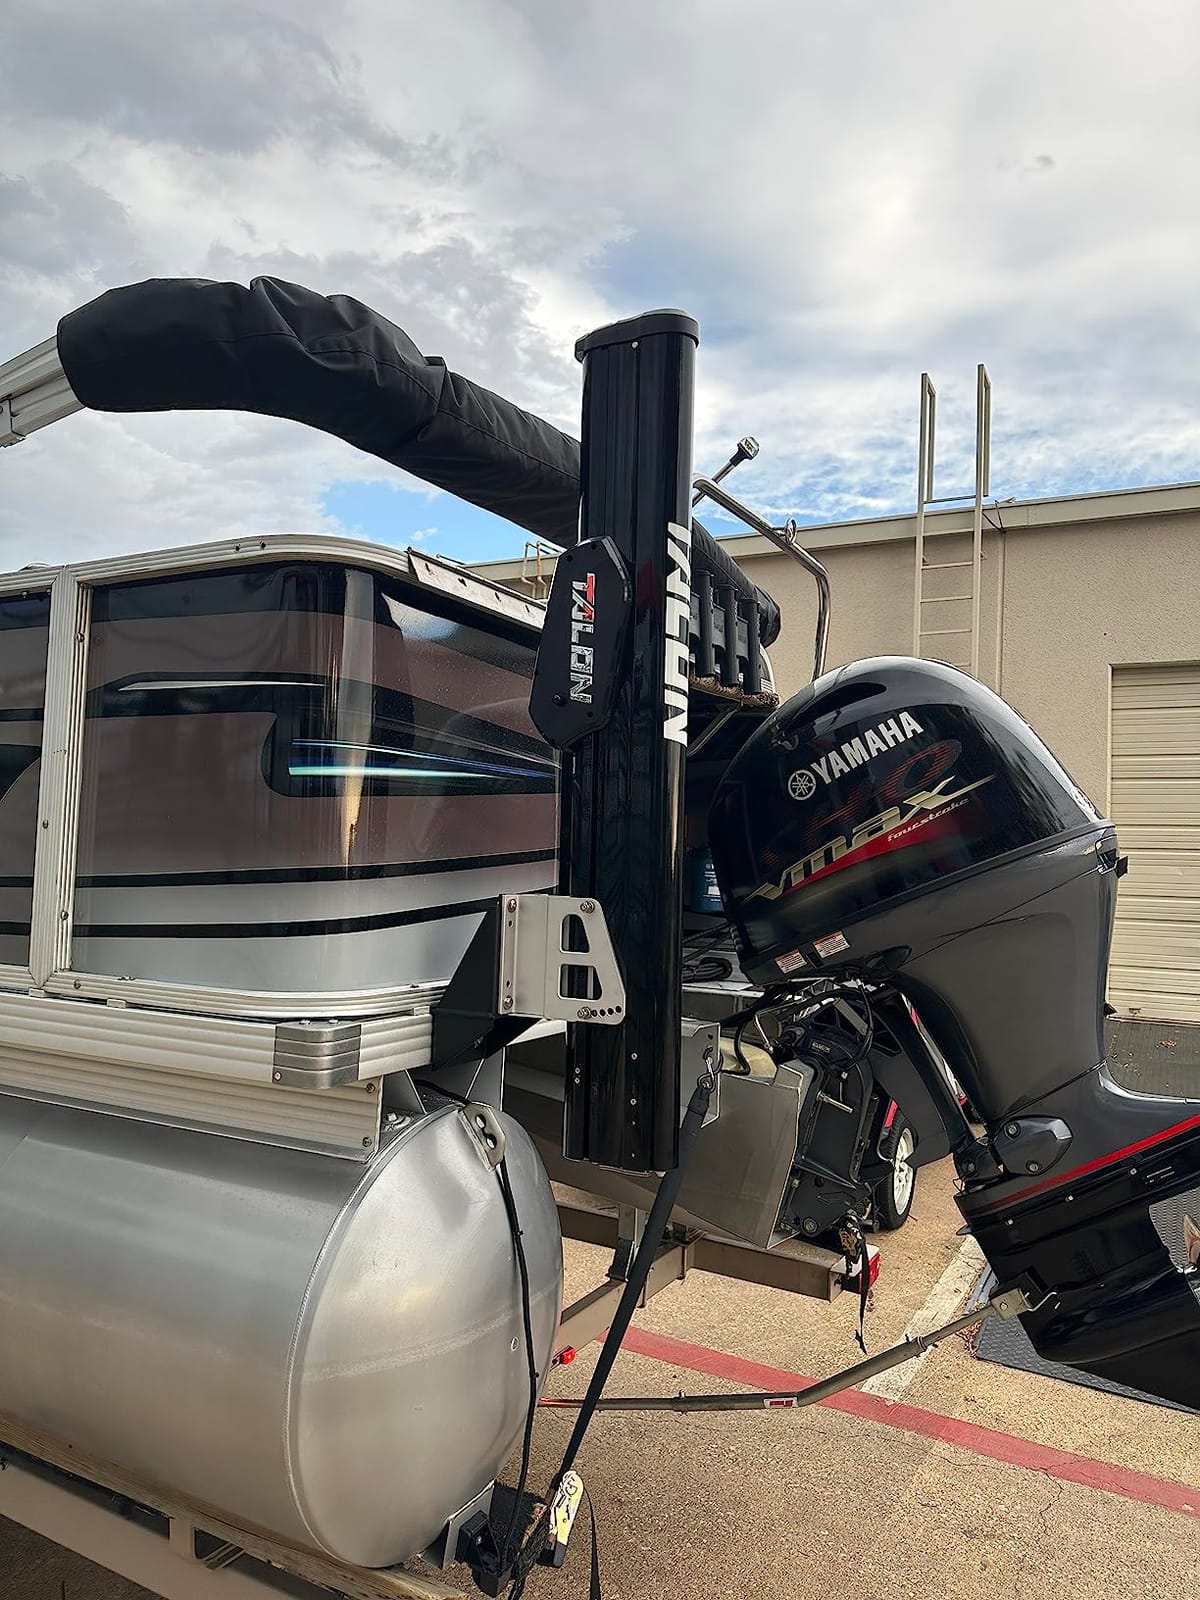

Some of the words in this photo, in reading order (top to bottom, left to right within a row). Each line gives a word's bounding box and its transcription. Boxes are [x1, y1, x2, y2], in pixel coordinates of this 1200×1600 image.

[569, 572, 596, 704] TALON
[809, 711, 925, 785] YAMAHA
[887, 799, 970, 843] fourstroke
